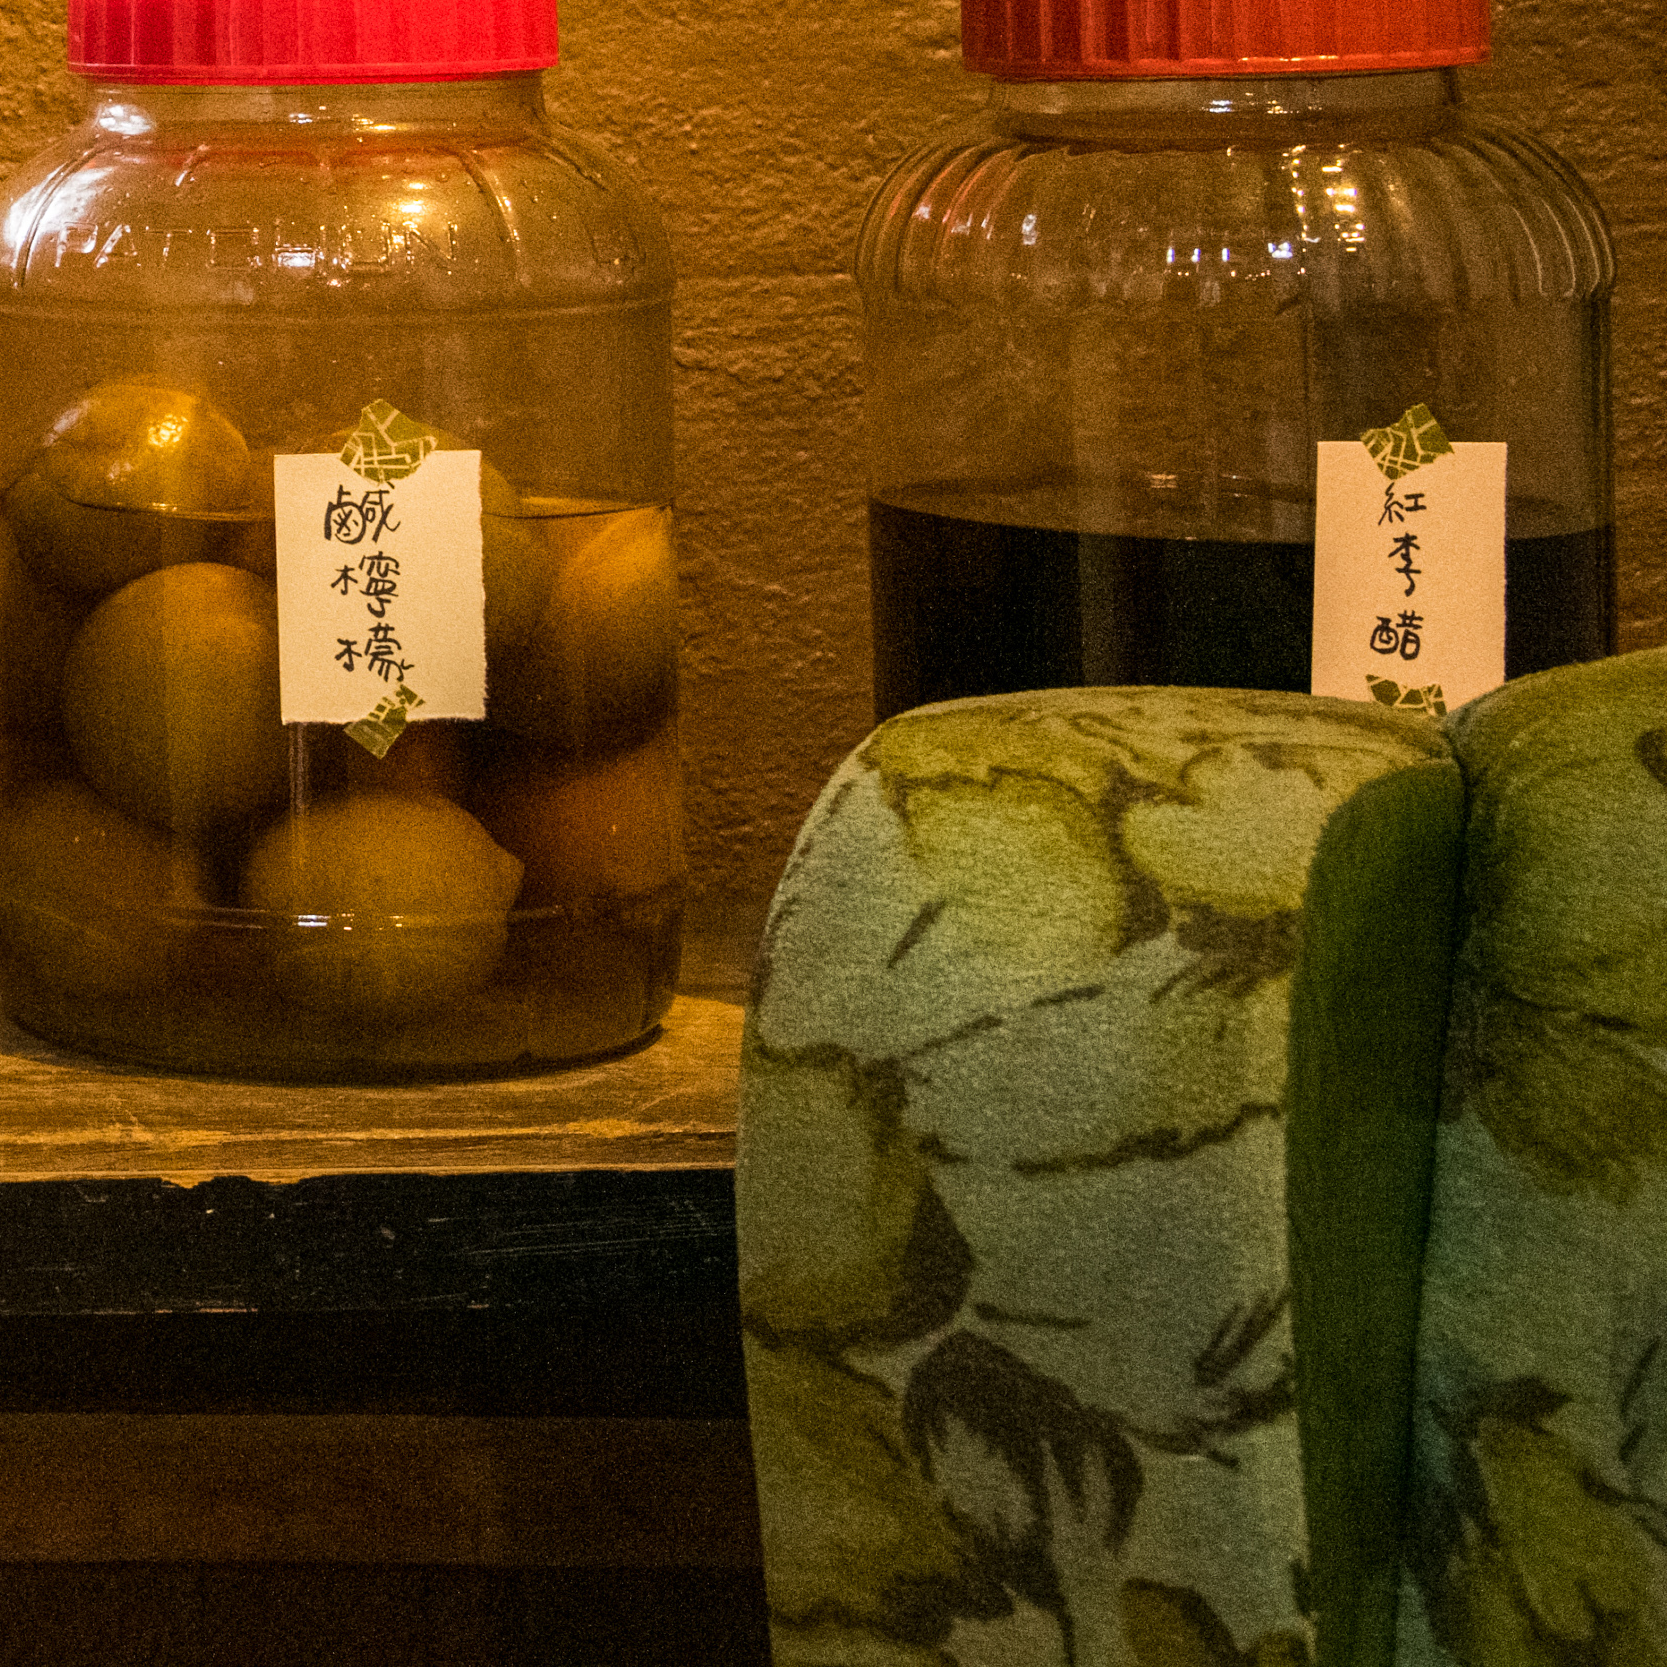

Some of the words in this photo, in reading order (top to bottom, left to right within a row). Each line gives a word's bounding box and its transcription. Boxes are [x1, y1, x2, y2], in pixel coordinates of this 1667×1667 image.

[324, 481, 415, 682] 鹹檸檬
[1370, 482, 1426, 660] 紅李醋
